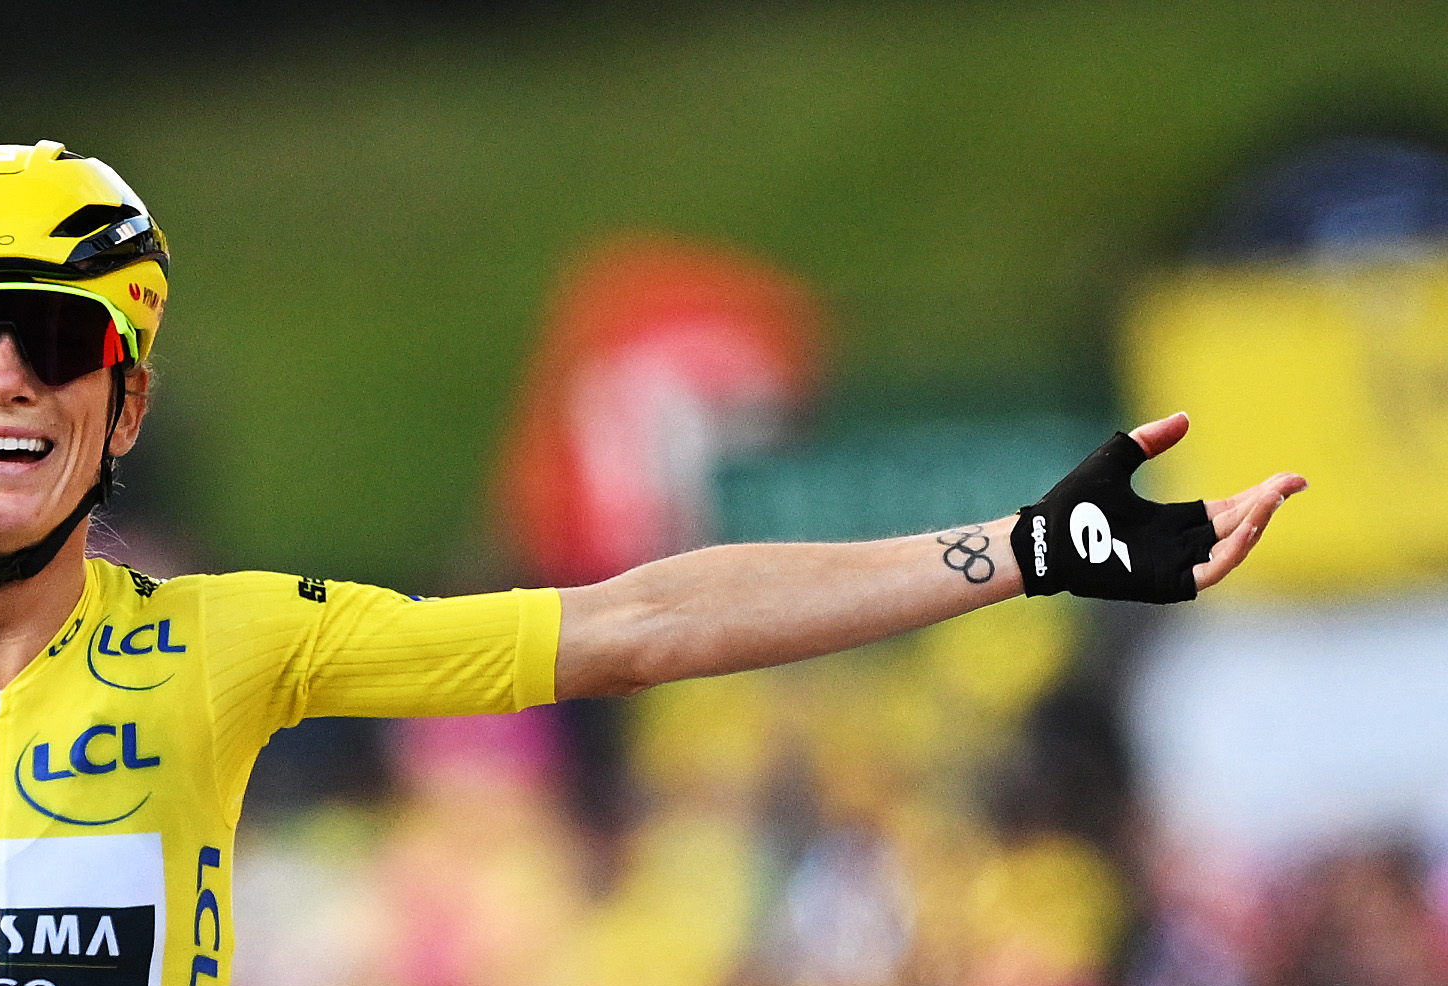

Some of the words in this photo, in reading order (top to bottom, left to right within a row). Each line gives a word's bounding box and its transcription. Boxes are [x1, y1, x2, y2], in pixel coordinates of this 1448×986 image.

[1030, 515, 1048, 577] GripGrab
[97, 619, 187, 656] LCL
[32, 722, 161, 782] LCL
